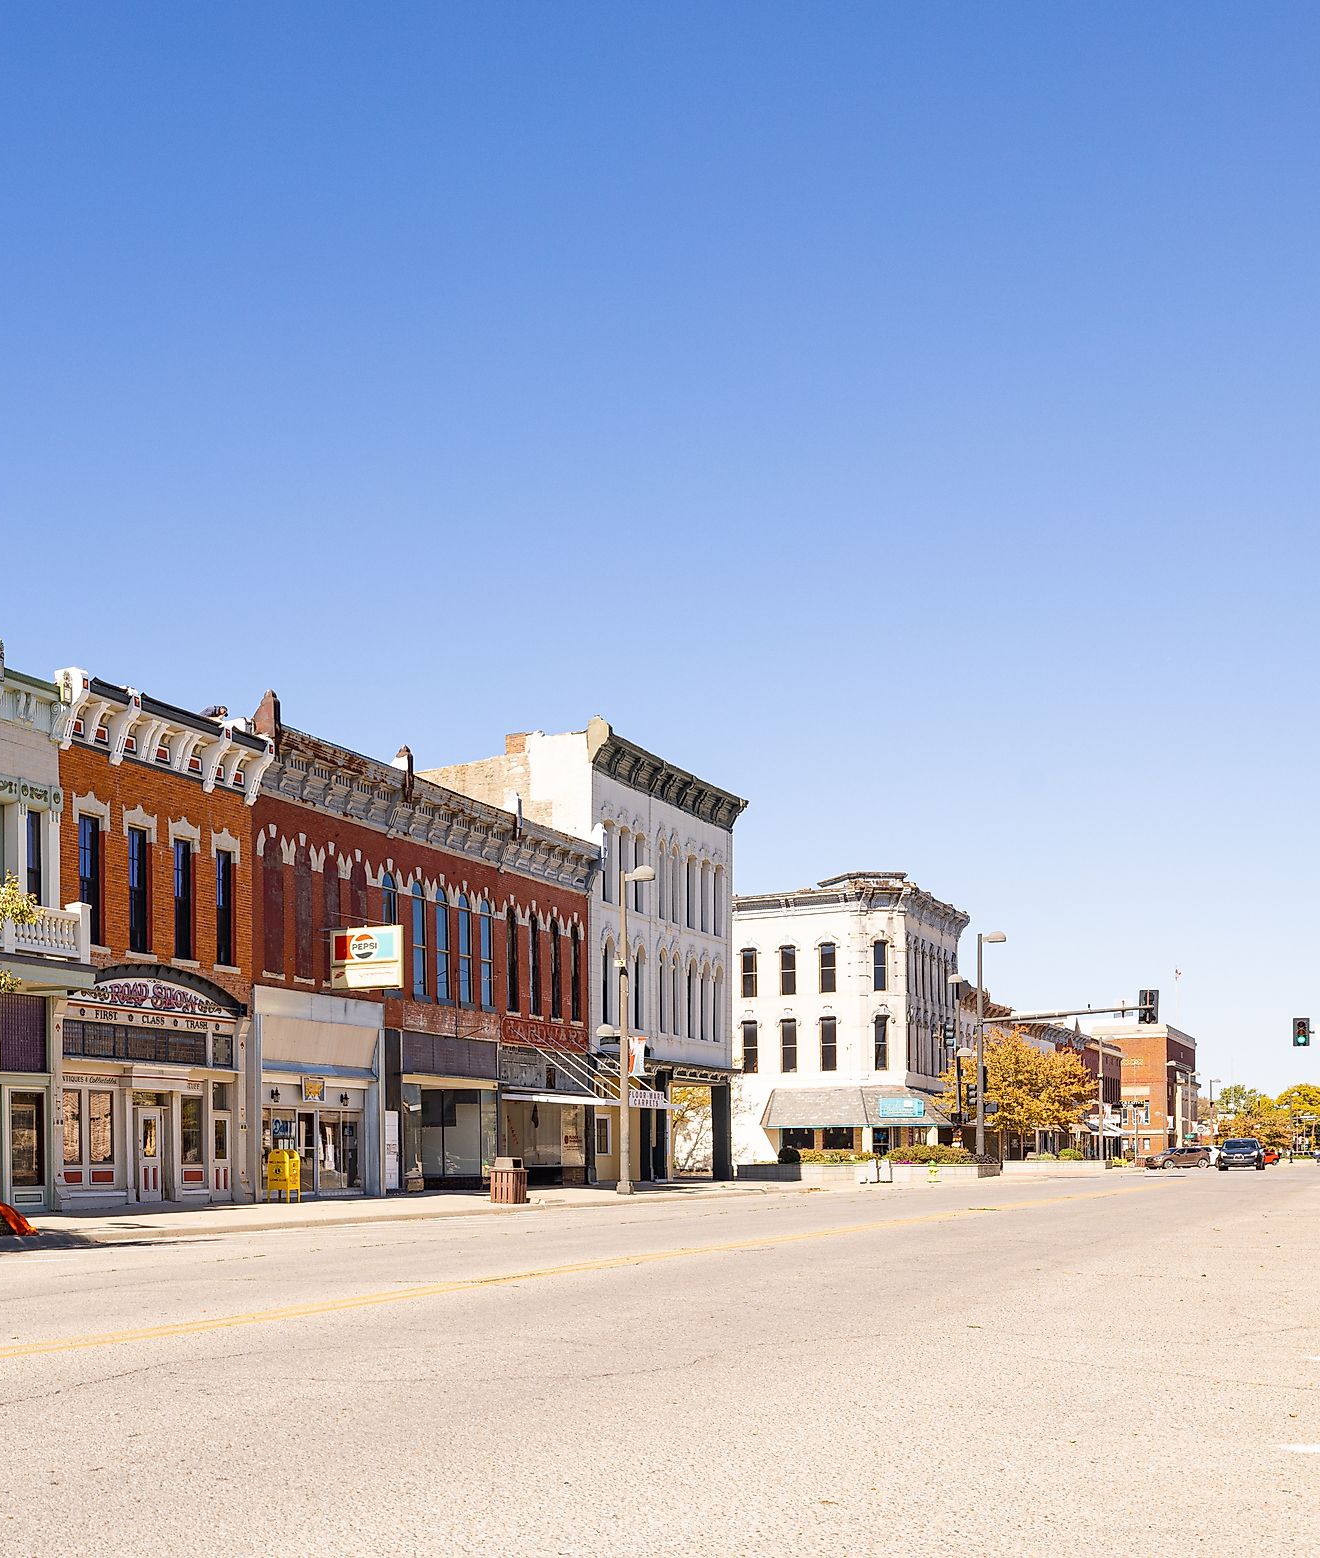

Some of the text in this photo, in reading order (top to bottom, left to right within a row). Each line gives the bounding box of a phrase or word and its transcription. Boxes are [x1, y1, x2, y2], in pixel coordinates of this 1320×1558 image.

[352, 942, 378, 950] PEPSI
[109, 982, 199, 1013] ROAD SHOW
[95, 1010, 208, 1030] FIRST CLASS TRASH
[634, 1099, 659, 1107] CARPETS
